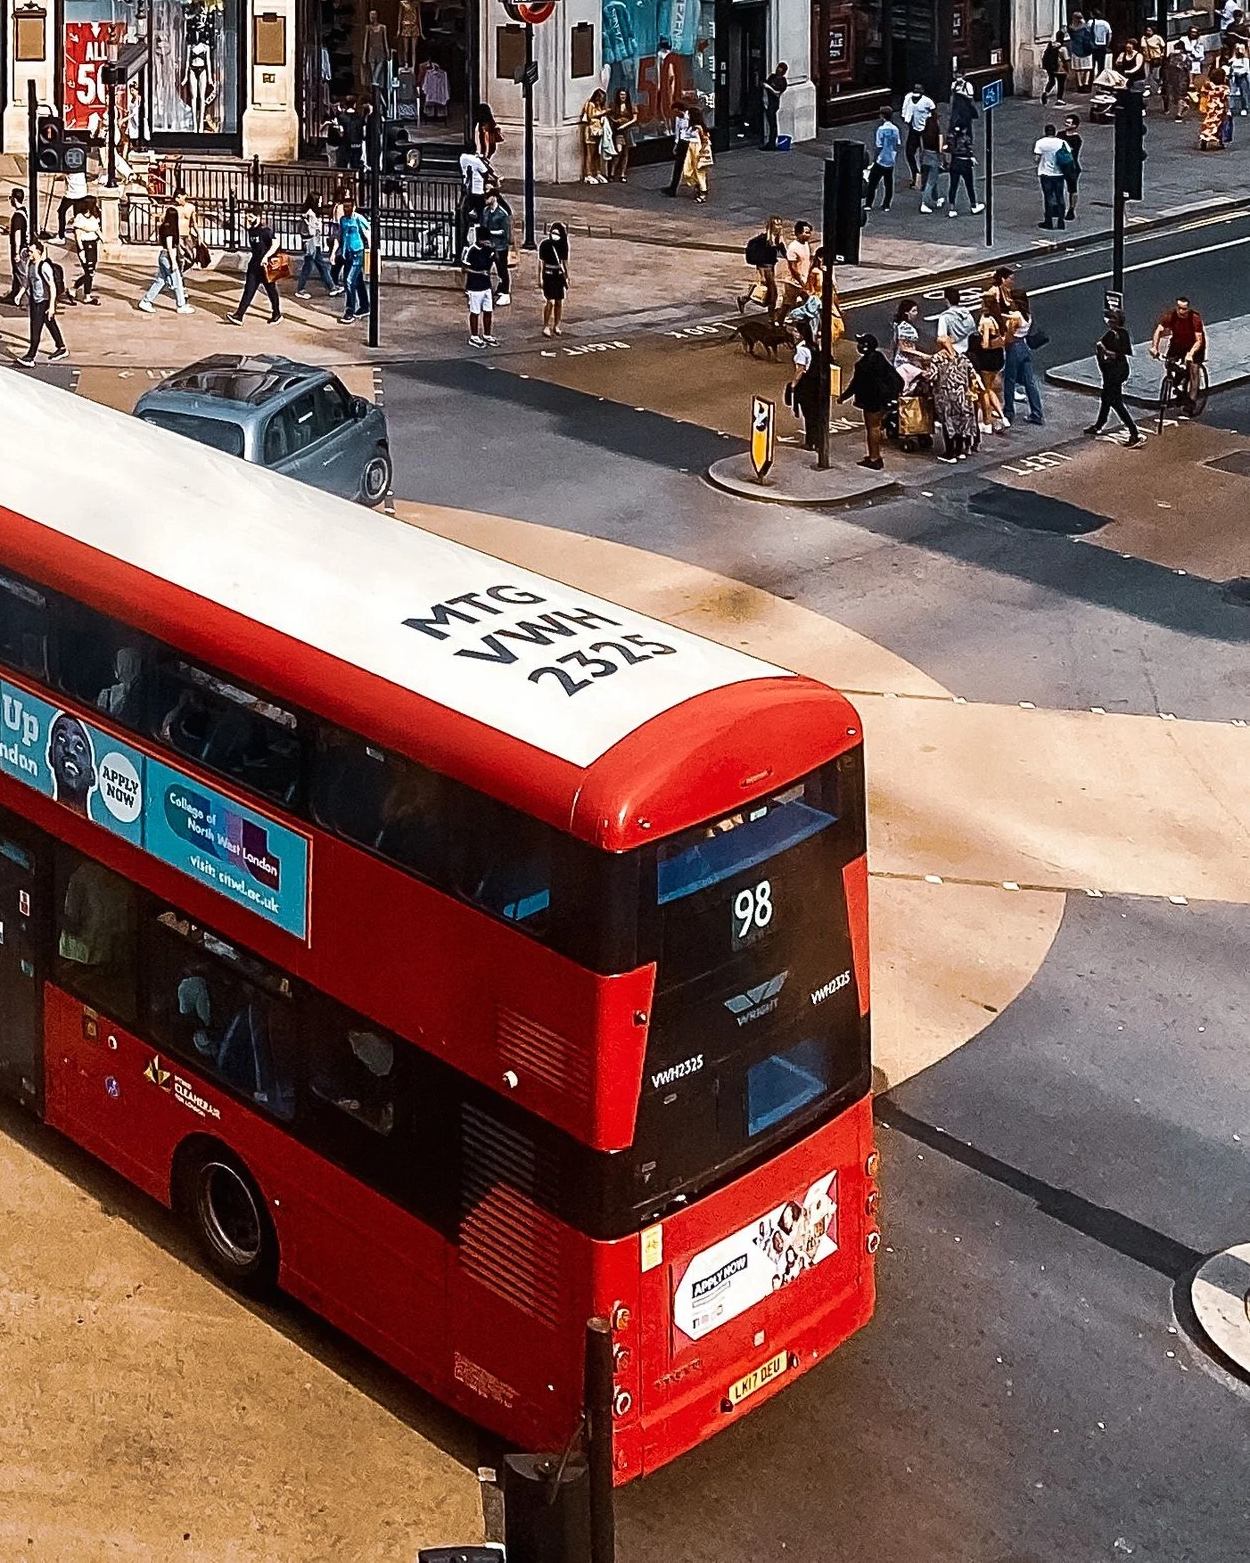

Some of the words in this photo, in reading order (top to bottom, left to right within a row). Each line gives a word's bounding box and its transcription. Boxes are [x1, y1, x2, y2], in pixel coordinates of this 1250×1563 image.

[85, 41, 107, 62] ALL
[830, 37, 844, 48] ALE
[664, 322, 738, 339] LOOK
[1000, 450, 1073, 477] LEFT
[400, 584, 547, 641] MTG
[452, 607, 624, 665] VWH
[526, 633, 678, 697] 2325
[2, 693, 41, 748] Up
[102, 765, 140, 795] APPLY
[106, 782, 136, 809] NOW
[169, 792, 205, 820] College
[206, 813, 218, 826] of
[187, 817, 216, 842] North
[217, 832, 241, 856] West
[242, 846, 279, 877] London
[734, 880, 774, 938] 98
[810, 969, 852, 1006] VWH2325
[736, 997, 780, 1027] WRIGHT
[651, 1053, 705, 1089] VWH2325
[694, 1270, 725, 1296] APPLY
[722, 1255, 748, 1281] NOW
[734, 1369, 759, 1399] LK17
[759, 1361, 781, 1382] DEU
